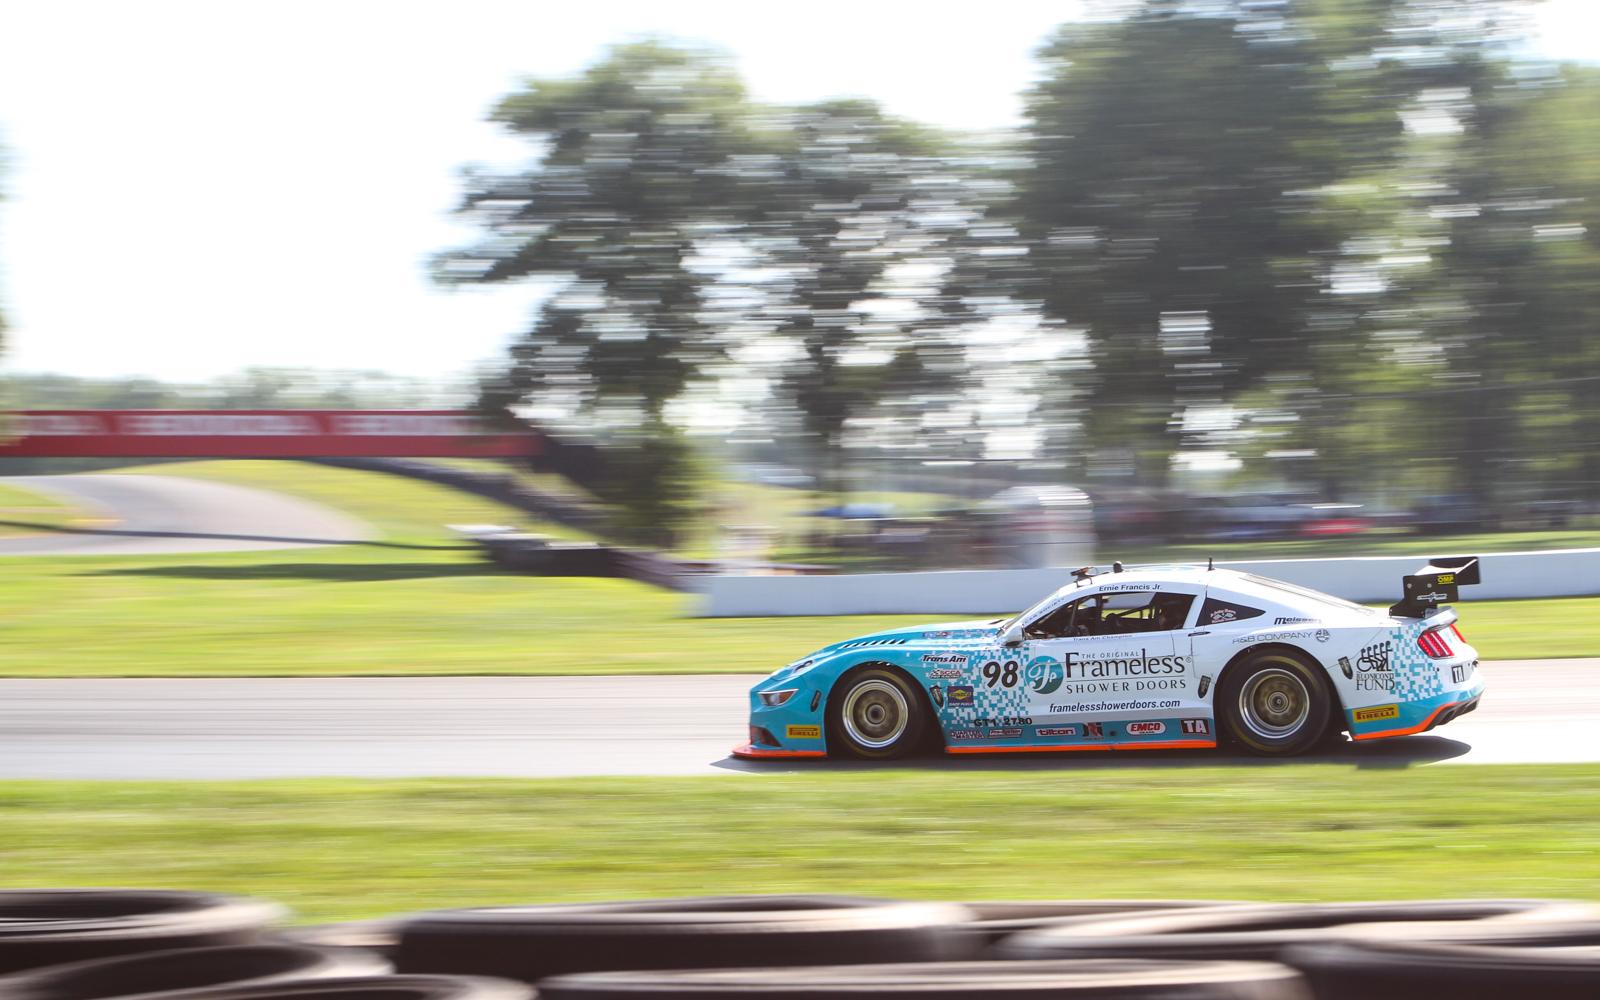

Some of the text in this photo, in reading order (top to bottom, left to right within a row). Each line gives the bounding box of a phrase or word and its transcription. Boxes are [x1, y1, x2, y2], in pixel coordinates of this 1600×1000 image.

[1098, 583, 1162, 592] Ernie Francis Jr.
[1257, 632, 1313, 642] COMPANY
[922, 654, 967, 663] Trans Am
[1100, 651, 1140, 659] ORIGINAL
[1065, 648, 1186, 678] Frameless
[982, 660, 1019, 688] 98
[1453, 666, 1464, 682] TA
[1066, 679, 1187, 694] SHOWER DOORS
[1356, 679, 1395, 691] FUND
[1049, 699, 1181, 713] framelessshowerdoors.com
[1357, 707, 1395, 720] PIRELLI
[973, 717, 1033, 727] GT1 2780
[1131, 722, 1161, 731] EMCO
[1184, 719, 1207, 733] TA
